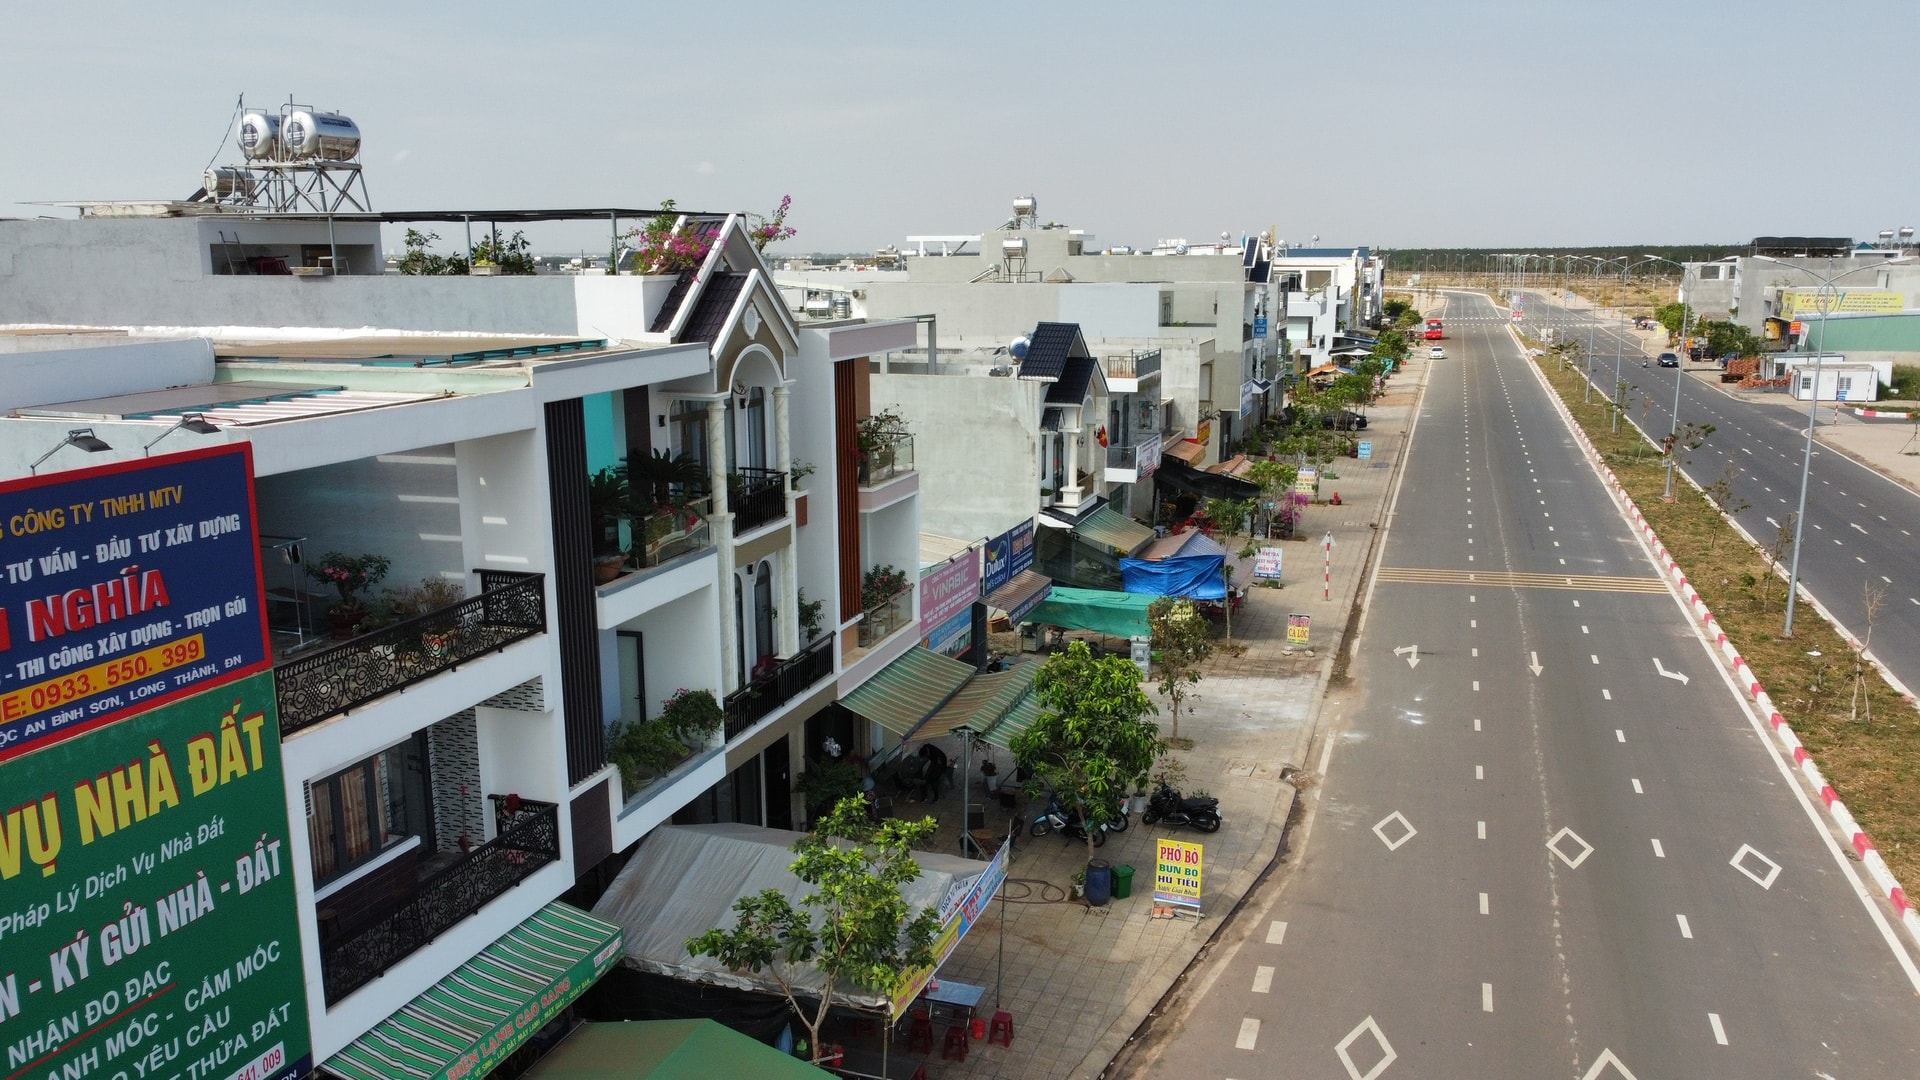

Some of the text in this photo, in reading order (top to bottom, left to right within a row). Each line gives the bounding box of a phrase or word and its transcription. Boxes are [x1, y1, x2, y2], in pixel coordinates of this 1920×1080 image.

[5, 558, 33, 585] TƯ
[38, 546, 78, 577] VẤN
[95, 535, 132, 564] ĐẦU
[138, 530, 161, 553] TƯ
[165, 523, 194, 548] XÂY
[199, 513, 241, 540] DỰNG
[10, 507, 66, 537] CÔNG
[69, 501, 94, 525] TY
[100, 492, 146, 519] TNHH
[149, 485, 183, 510] MTV
[25, 564, 171, 643] NGHĨA
[932, 566, 969, 601] VINABIC
[986, 557, 1005, 578] Dulux
[16, 656, 45, 681] THI
[48, 643, 94, 671] CÔNG
[97, 631, 127, 657] XÂY
[131, 619, 172, 648] DỰNG
[184, 605, 221, 631] TRỌN
[224, 597, 247, 618] GÓI
[161, 639, 200, 667] 399
[24, 719, 46, 737] AN
[51, 707, 84, 727] BÌNH
[89, 695, 125, 715] SƠN,
[129, 681, 166, 701] LONG
[224, 654, 242, 668] ĐN
[0, 698, 267, 881] VỤ NHÀ ĐẤT
[0, 814, 225, 940] Pháp Lý Dịch Vụ Nhà Đất
[1160, 844, 1199, 864] PHỞ BÒ
[50, 927, 90, 995] KÝ
[100, 901, 151, 967] GỬI
[156, 868, 215, 938] NHÀ
[236, 832, 281, 896] ĐẤT
[7, 961, 172, 1070] NHẬN ĐO ĐẠC
[105, 1012, 160, 1062] MỐC
[184, 969, 231, 1013] CẮM
[236, 940, 281, 986] MỐC
[446, 976, 571, 1080] ĐIỆN LẠNH CAO SANG
[133, 1005, 231, 1079] YÊU CẦU
[186, 1002, 291, 1080] THỬA ĐẤT
[262, 1048, 281, 1073] 009
